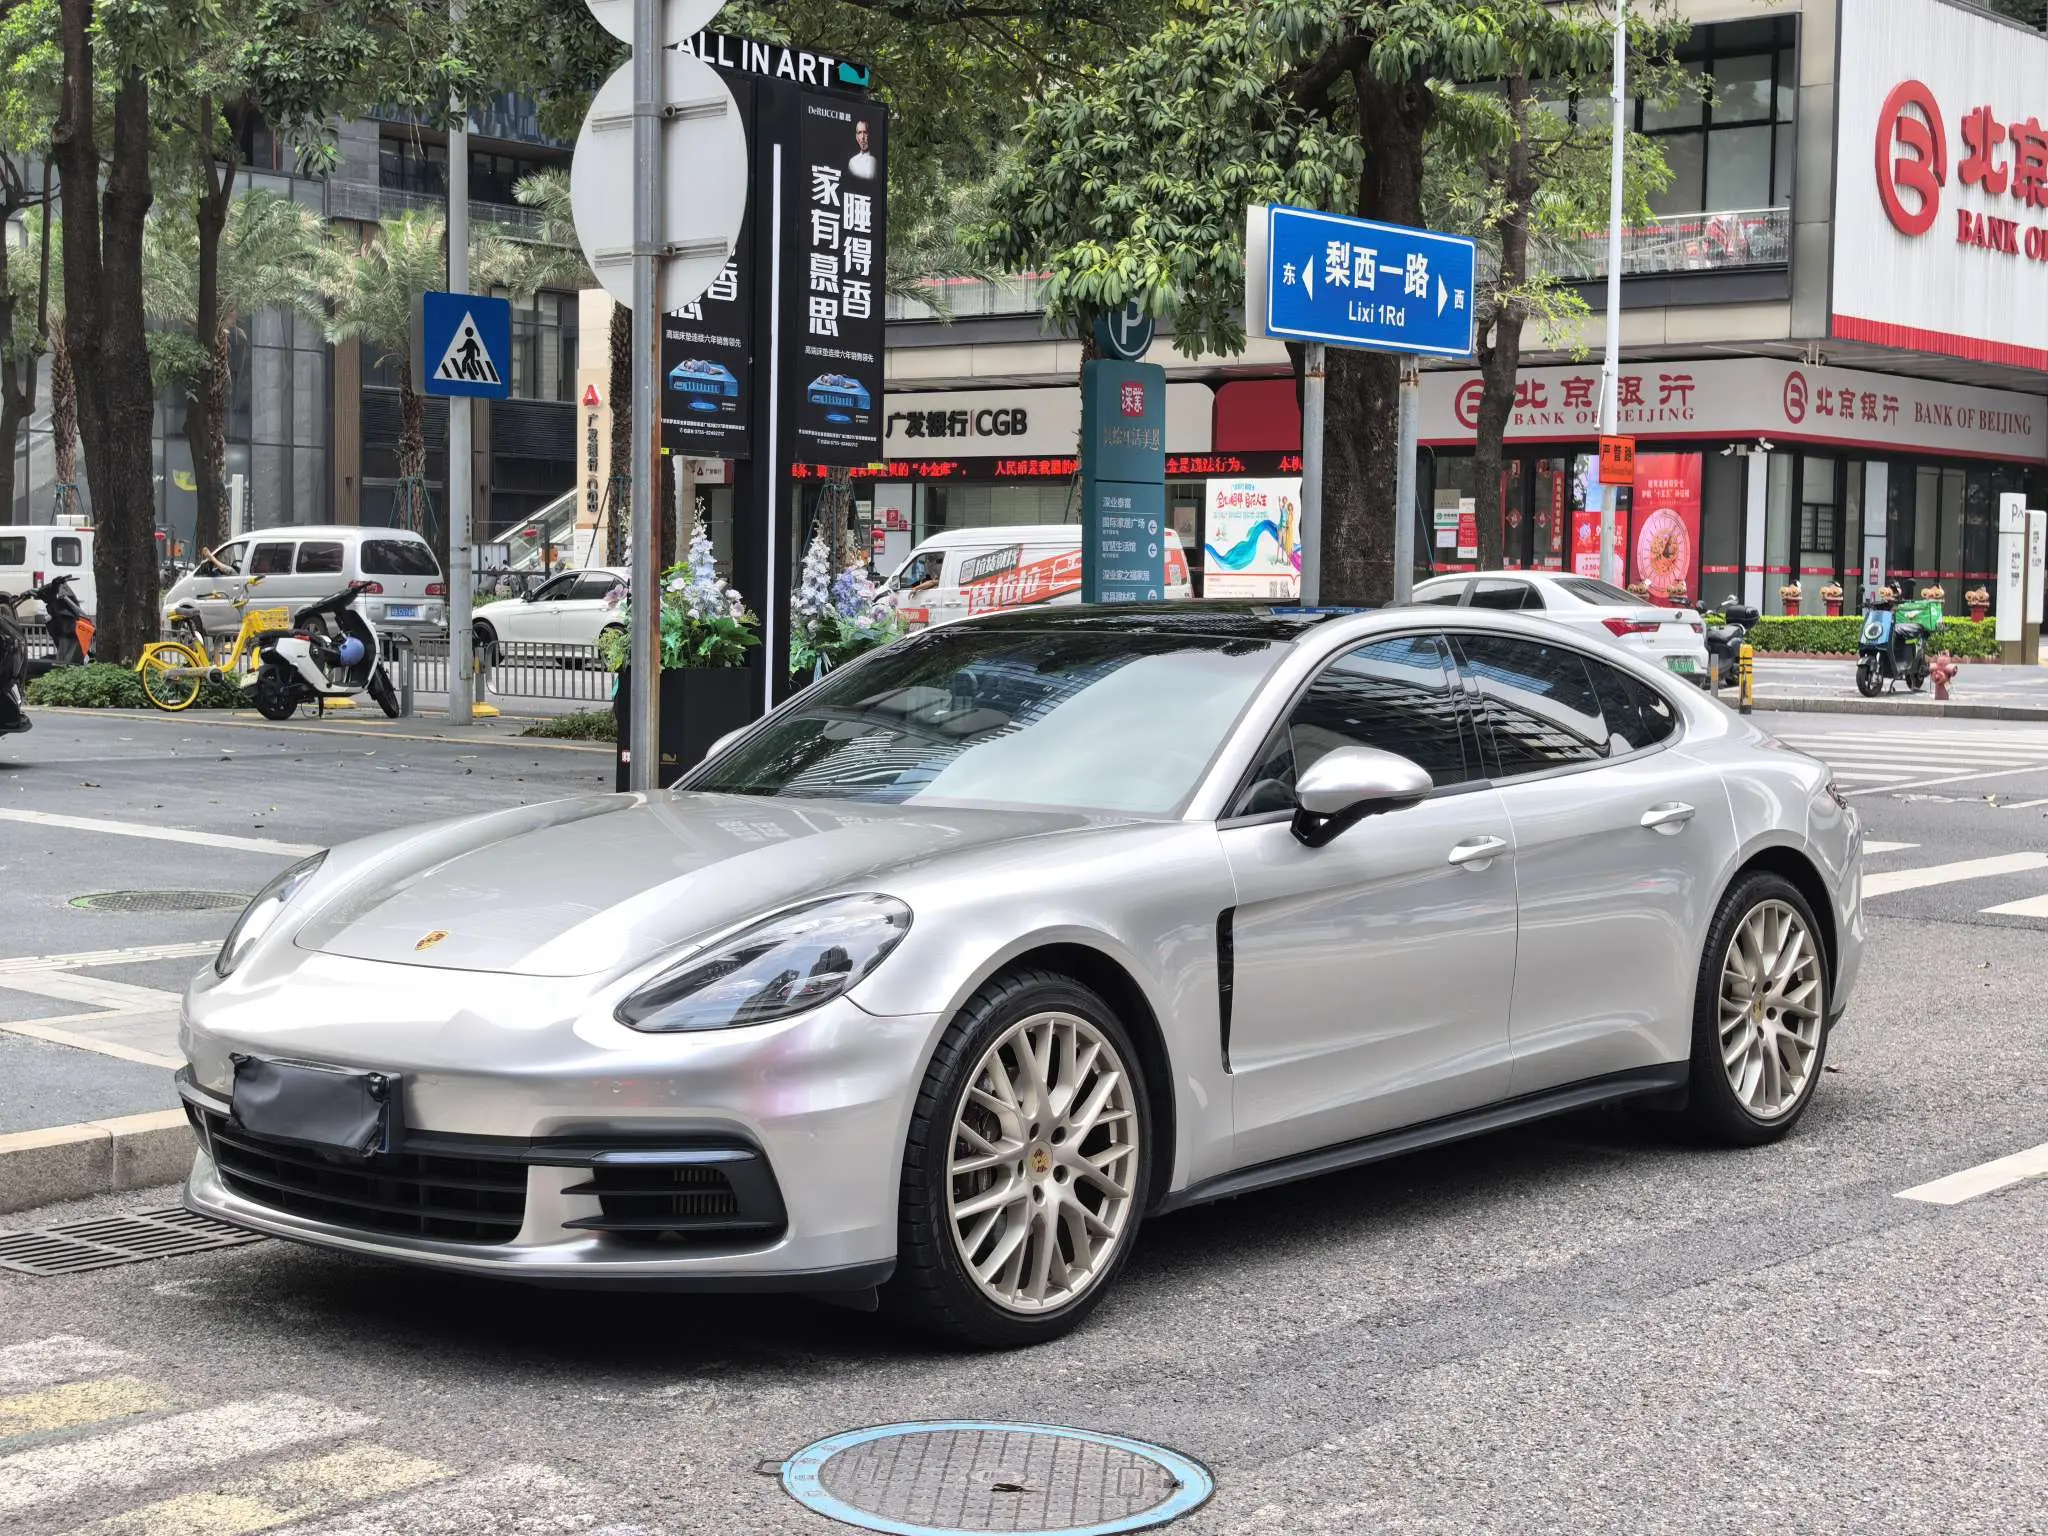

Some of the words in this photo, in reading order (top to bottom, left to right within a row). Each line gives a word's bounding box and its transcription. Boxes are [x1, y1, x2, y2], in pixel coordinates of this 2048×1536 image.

[677, 31, 734, 68] ALL
[742, 40, 769, 75] IN
[776, 48, 835, 87] ART
[1957, 104, 2048, 208] 北京
[809, 164, 842, 337] 家有慕思
[842, 191, 872, 320] 睡得香
[1956, 208, 2020, 256] BANK
[1282, 262, 1297, 286] 东
[1325, 240, 1430, 299] 梨西一路
[1454, 288, 1465, 310] 西
[1120, 296, 1144, 345] P
[1348, 300, 1375, 324] Lixi
[886, 410, 968, 439] 广发银行
[975, 408, 1028, 437] CGB
[1513, 412, 1565, 426] BANK
[1815, 386, 1900, 427] 北京银行
[1914, 401, 1953, 427] BANK
[1957, 407, 1976, 429] OF
[1979, 409, 2032, 436] BEIJING
[586, 478, 599, 513] CGB
